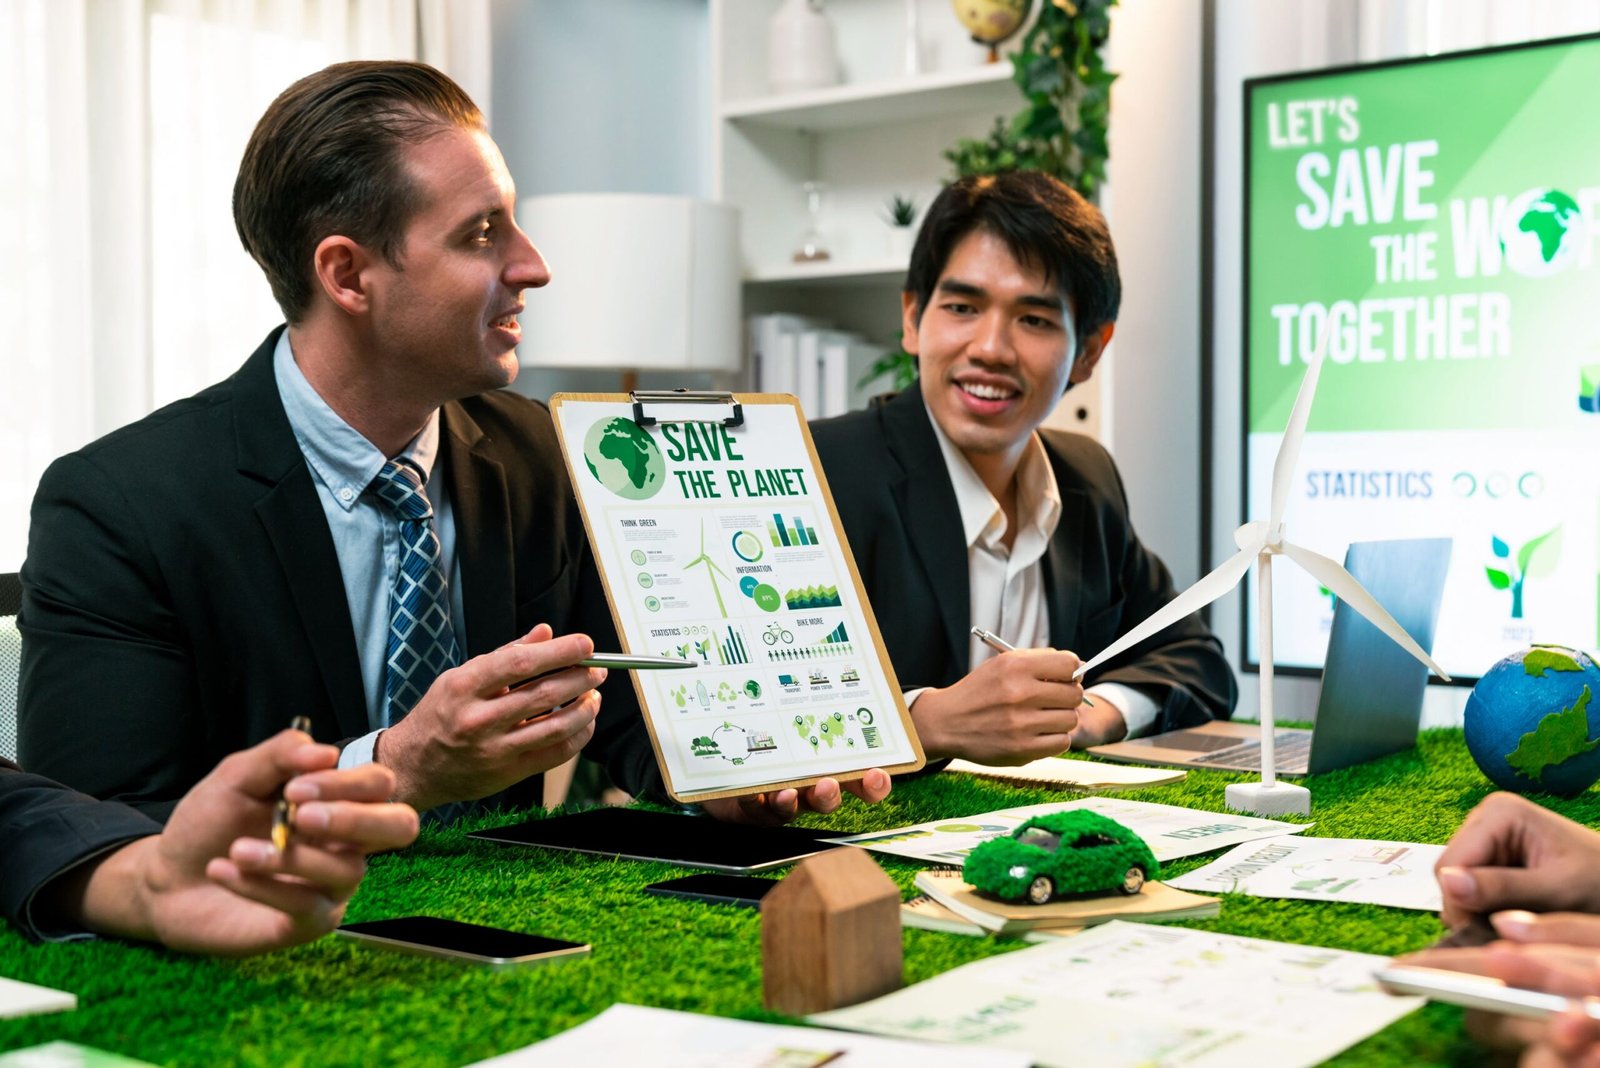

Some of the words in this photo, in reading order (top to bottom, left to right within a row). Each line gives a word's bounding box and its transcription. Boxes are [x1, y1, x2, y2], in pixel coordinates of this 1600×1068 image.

[1267, 96, 1360, 150] LET'S
[1295, 140, 1439, 230] SAVE
[1370, 232, 1439, 284] THE
[1271, 292, 1512, 366] TOGETHER
[662, 422, 744, 463] SAVE
[674, 470, 722, 499] THE
[728, 468, 809, 498] PLANET
[1305, 470, 1433, 499] STATISTICS
[620, 519, 638, 527] THINK
[639, 519, 657, 527] GREEN
[735, 565, 773, 574] INFORMATION
[650, 628, 681, 637] STATISTICS
[796, 618, 809, 627] BIKE
[809, 617, 824, 625] MORE
